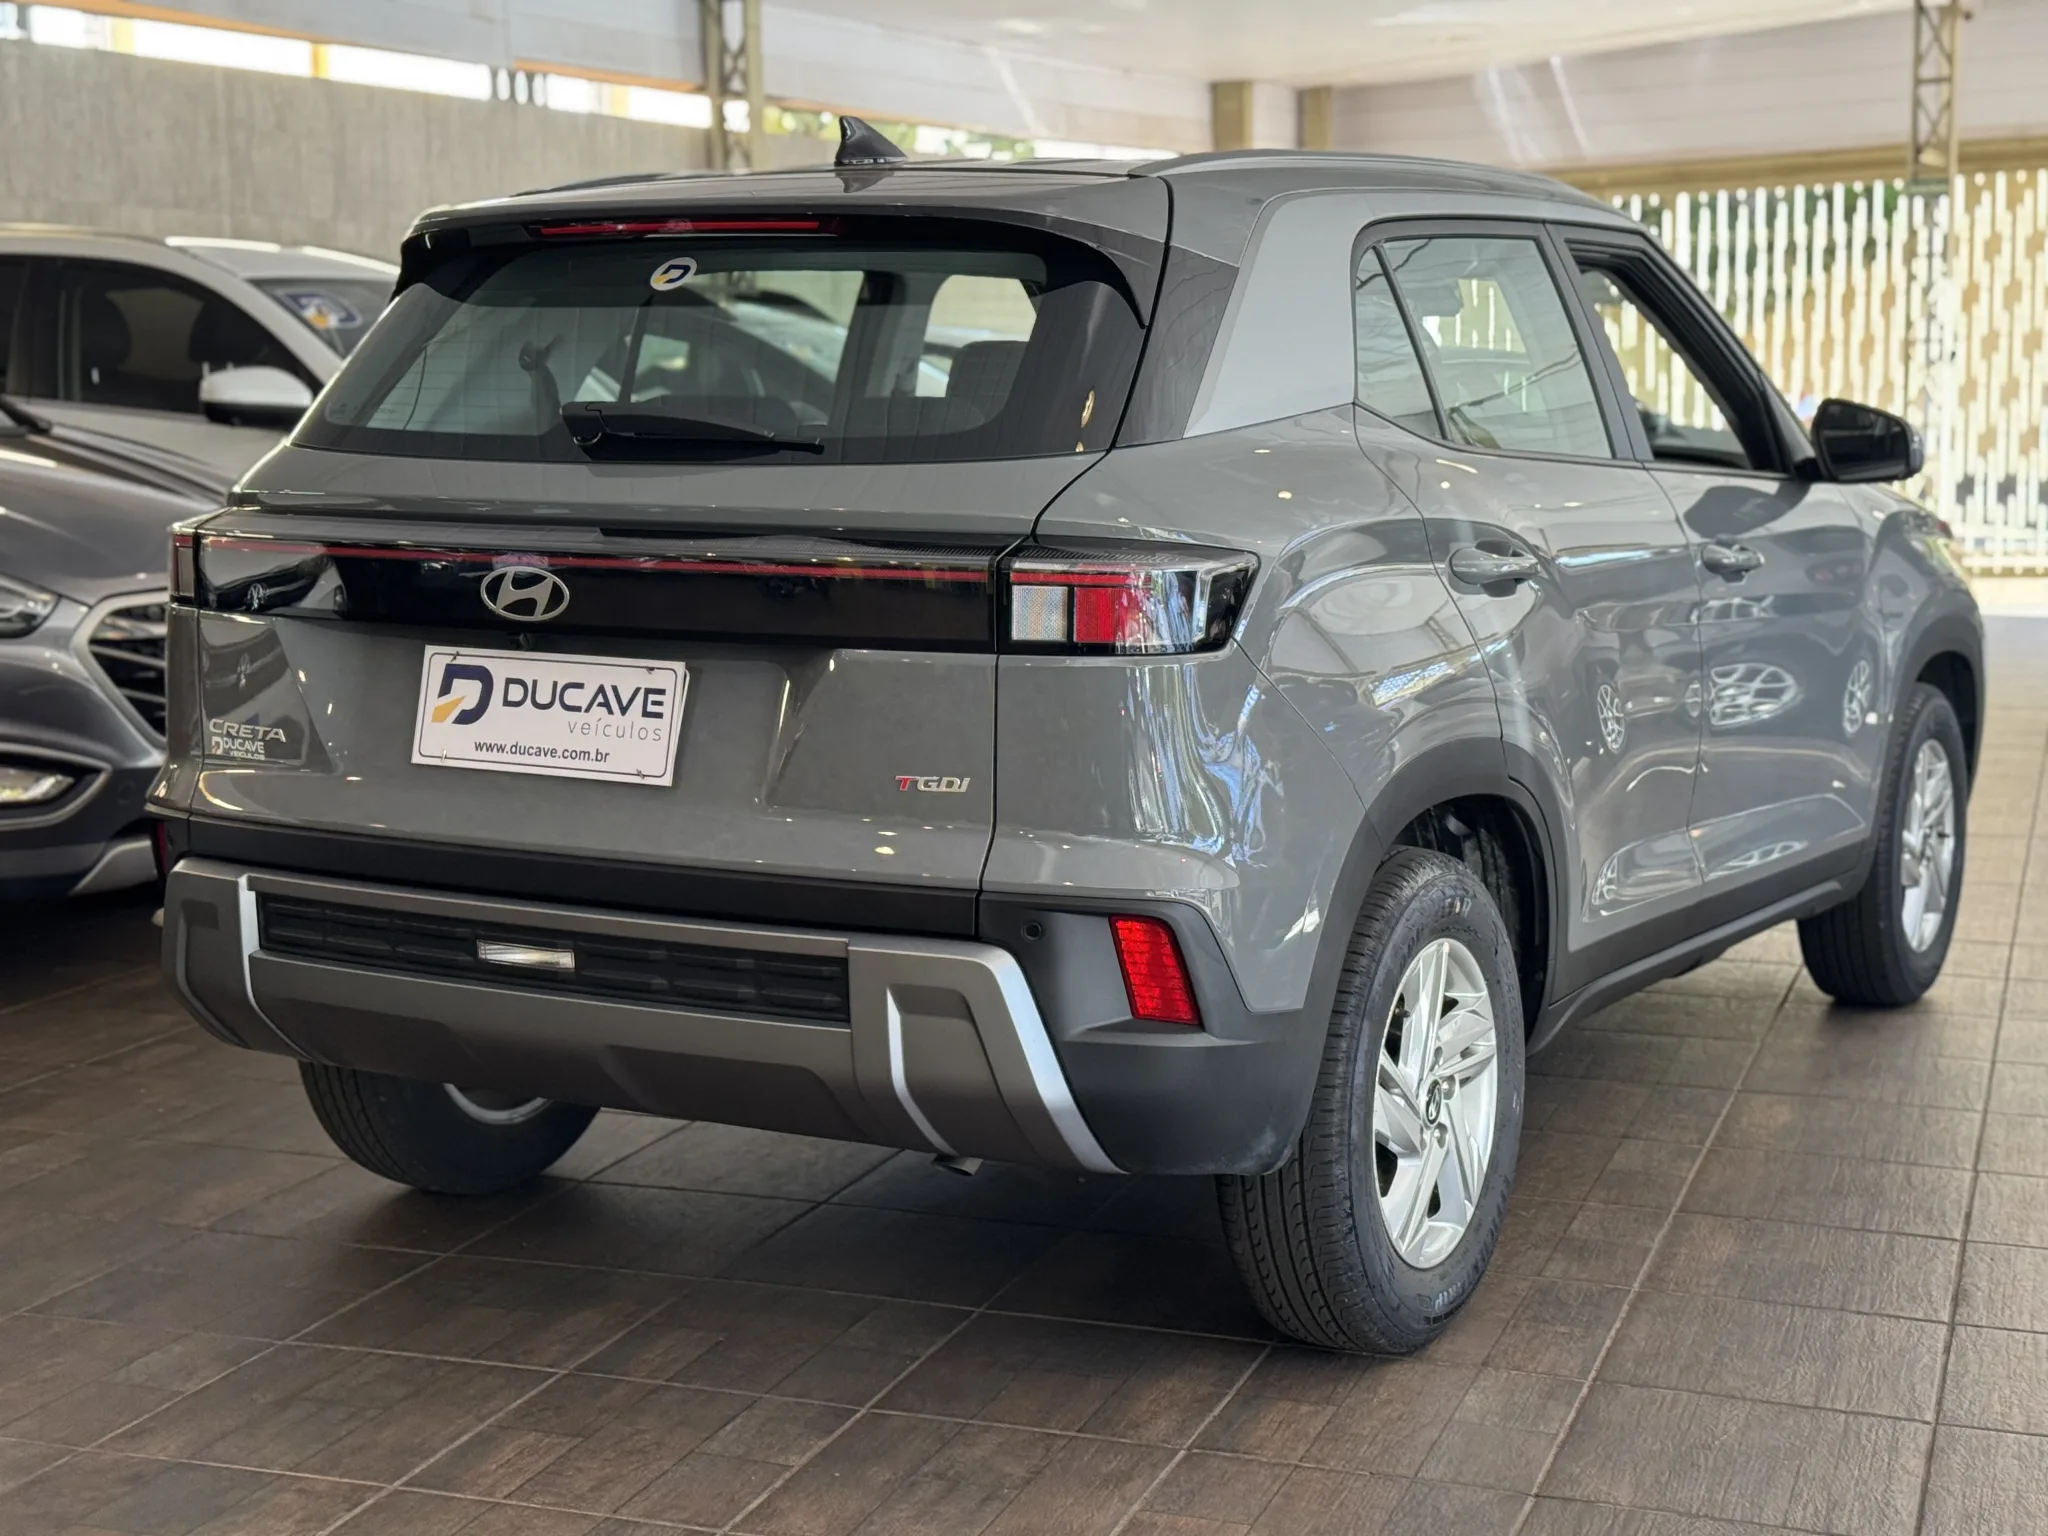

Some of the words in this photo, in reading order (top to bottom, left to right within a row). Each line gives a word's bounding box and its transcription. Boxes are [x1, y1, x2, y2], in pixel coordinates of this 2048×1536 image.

[502, 677, 667, 719] DUCAVE
[209, 718, 287, 743] CRETA
[567, 718, 662, 742] veículos
[223, 737, 265, 754] DUCAVE
[474, 741, 610, 763] www.ducave.com.br
[895, 775, 971, 793] TGDI
